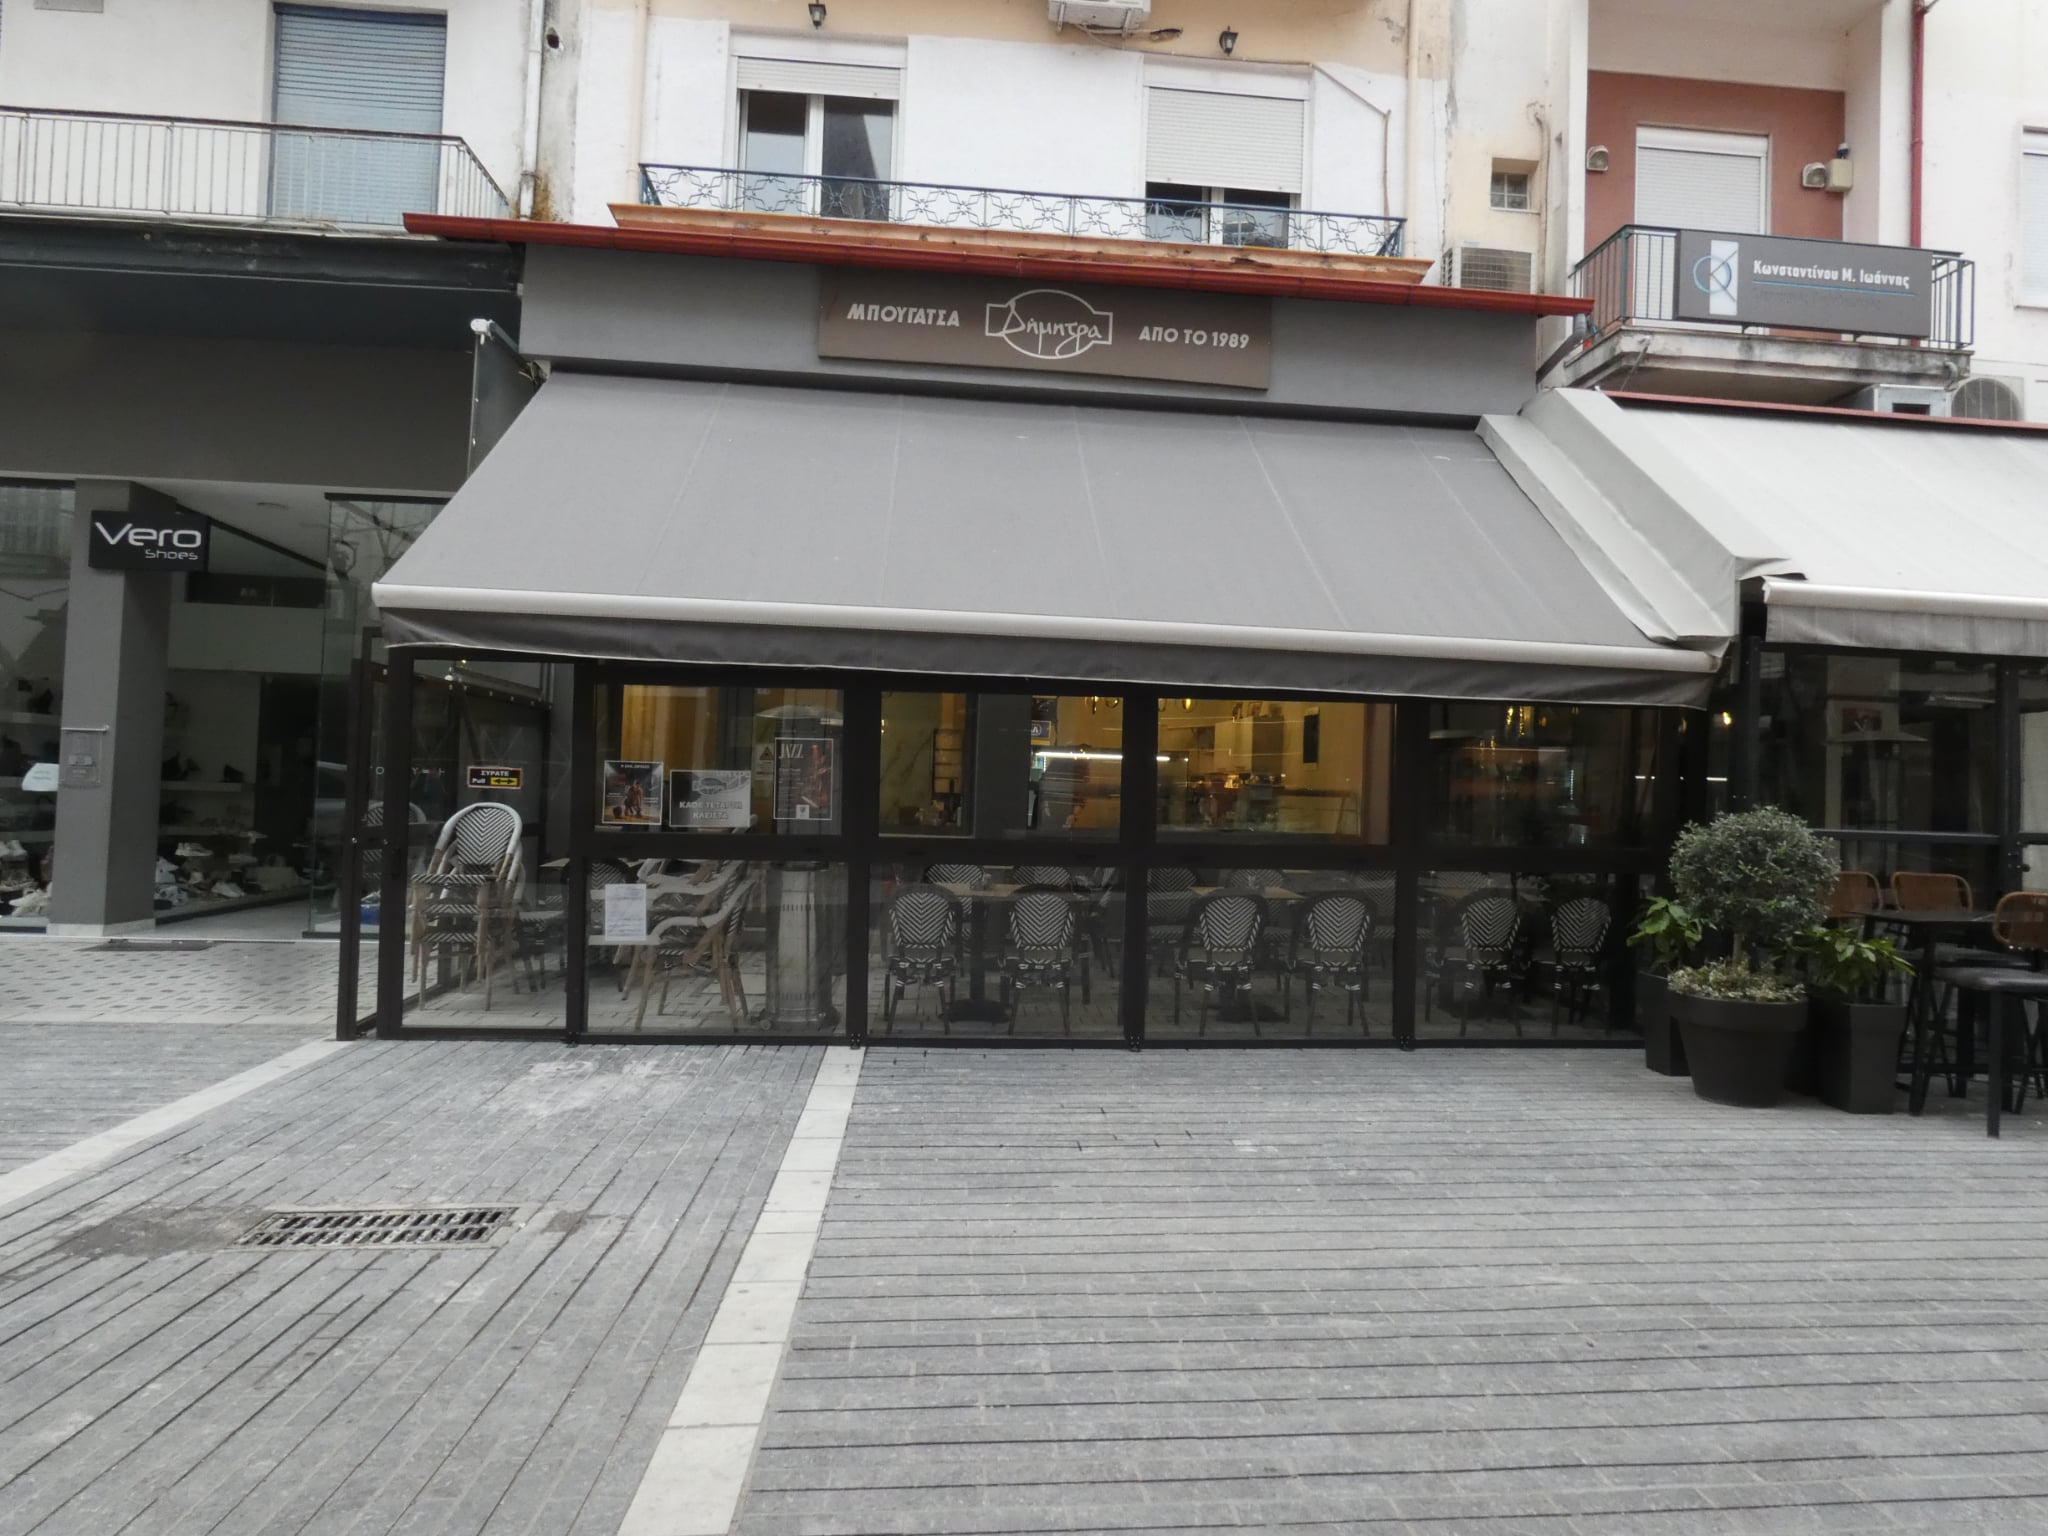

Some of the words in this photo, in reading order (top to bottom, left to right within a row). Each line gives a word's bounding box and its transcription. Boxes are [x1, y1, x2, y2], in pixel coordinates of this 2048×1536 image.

[1753, 260, 1839, 281] Κωνσταντίνου
[1842, 268, 1856, 282] Μ.
[1860, 270, 1910, 289] Ιωάννης
[847, 303, 960, 327] ΜΠΟΥΓΑΤΣΑ
[1138, 325, 1179, 342] ΑΠΟ
[1184, 328, 1208, 345] ΤΟ
[1212, 331, 1250, 349] 1989
[94, 521, 202, 548] Vero
[145, 549, 199, 560] Shoes
[778, 744, 803, 759] JAZZ
